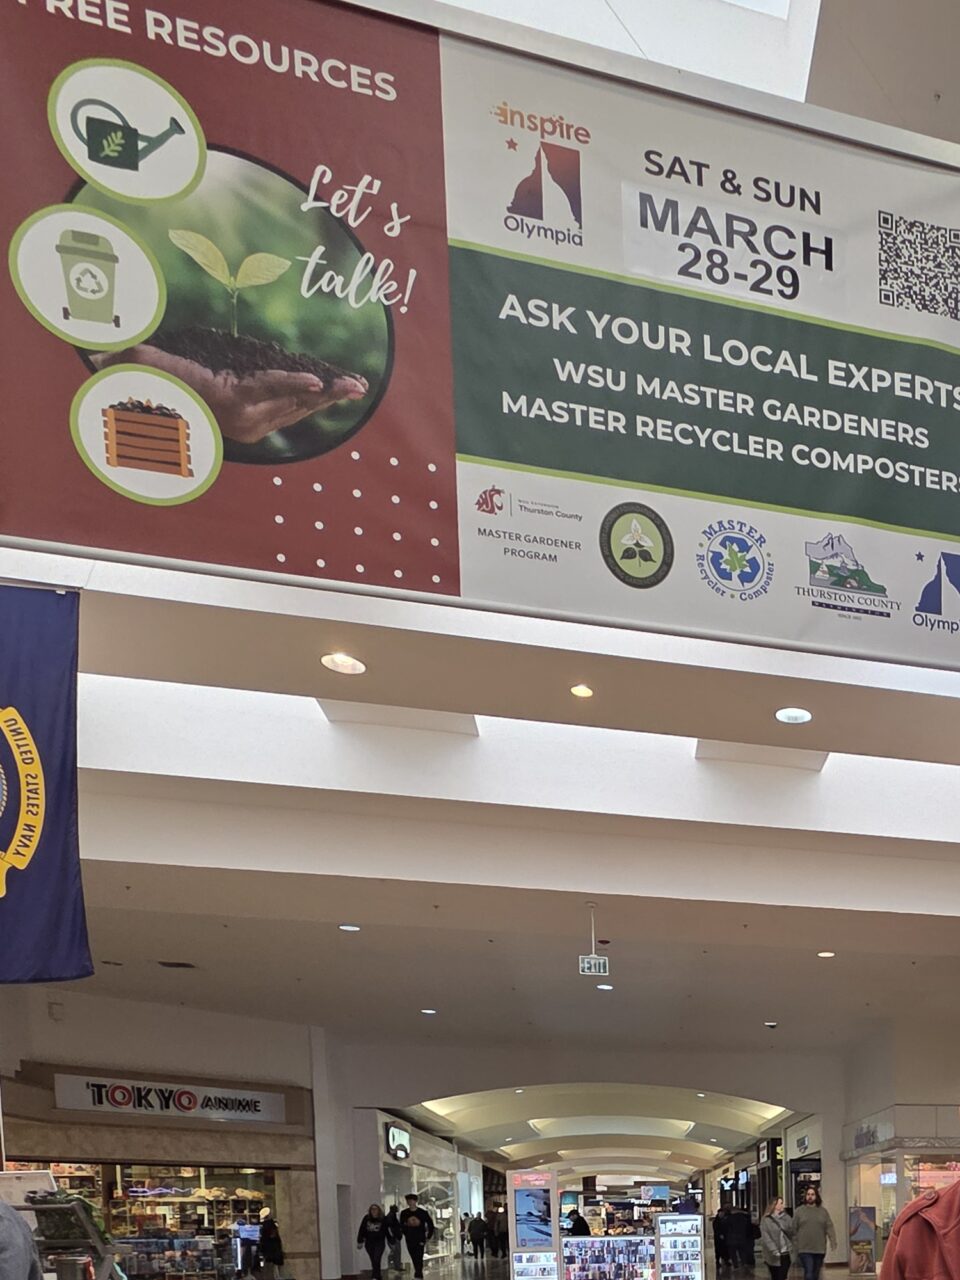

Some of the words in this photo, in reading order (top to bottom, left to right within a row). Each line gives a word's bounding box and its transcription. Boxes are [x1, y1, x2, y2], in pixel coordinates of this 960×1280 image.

[146, 10, 398, 101] RESOURCES
[496, 101, 592, 146] inspire
[300, 164, 411, 238] Let's
[643, 149, 710, 187] SAT
[720, 168, 743, 197] &
[753, 177, 822, 216] SUN
[503, 214, 584, 248] Olympia
[639, 192, 834, 271] MARCH
[296, 253, 417, 314] talk!
[676, 242, 801, 300] 28-29
[498, 293, 577, 336] ASK
[586, 310, 692, 356] YOUR
[703, 335, 818, 383] LOCAL
[553, 358, 627, 392] WSU
[636, 373, 755, 417] MASTER
[762, 400, 930, 450] GARDENERS
[502, 392, 627, 435] MASTER
[636, 417, 784, 462] RECYCLER
[519, 504, 554, 517] Thurston
[555, 510, 583, 522] County
[702, 519, 767, 548] MASTER
[477, 527, 522, 542] MASTER
[524, 534, 582, 550] GARDENER
[503, 547, 558, 562] PROGRAM
[696, 553, 726, 598] Recycler
[739, 561, 775, 601] Composter
[795, 586, 855, 604] THURSTON
[857, 596, 901, 610] COUNTY
[584, 958, 605, 973] EXIT
[89, 1083, 198, 1112] TOKYO
[201, 1095, 262, 1113] ANIME
